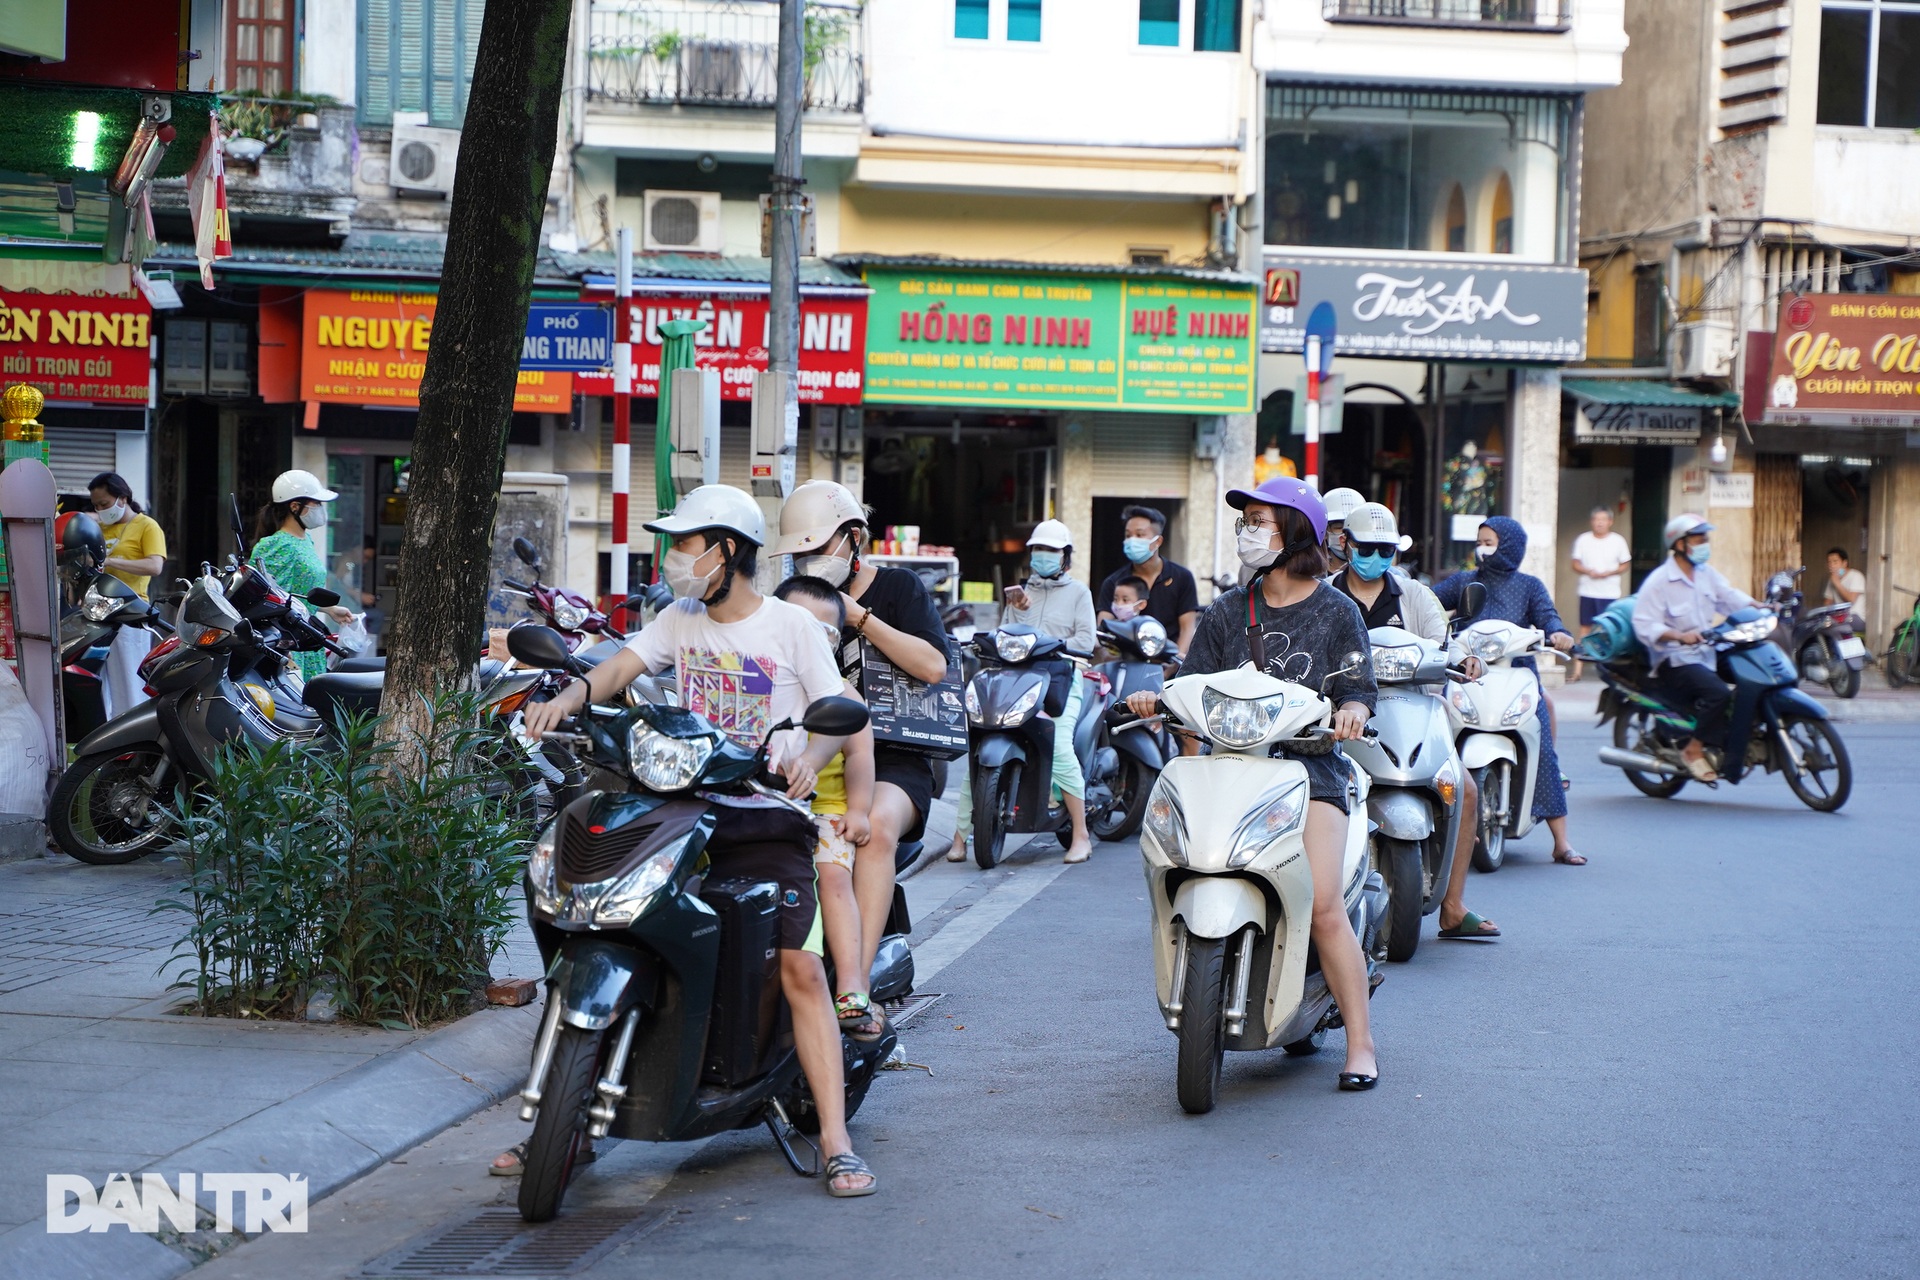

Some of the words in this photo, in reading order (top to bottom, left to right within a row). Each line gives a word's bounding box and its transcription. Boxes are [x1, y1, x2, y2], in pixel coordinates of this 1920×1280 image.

[543, 311, 580, 329] PHỐ
[1269, 306, 1294, 324] 81
[1831, 302, 1865, 318] BÁNH
[48, 309, 150, 348] NINH
[1003, 314, 1092, 348] NINH
[1188, 311, 1249, 338] NINH
[520, 336, 550, 360] NG
[555, 336, 606, 361] THAN
[1785, 330, 1862, 380] Yên
[3, 350, 31, 374] HỎI
[36, 357, 80, 379] TRỌN
[84, 356, 112, 377] GÓI
[329, 357, 379, 380] NHẬN
[1637, 411, 1696, 430] Tailor
[1275, 852, 1301, 871] HONDA
[691, 925, 718, 938] HONDA
